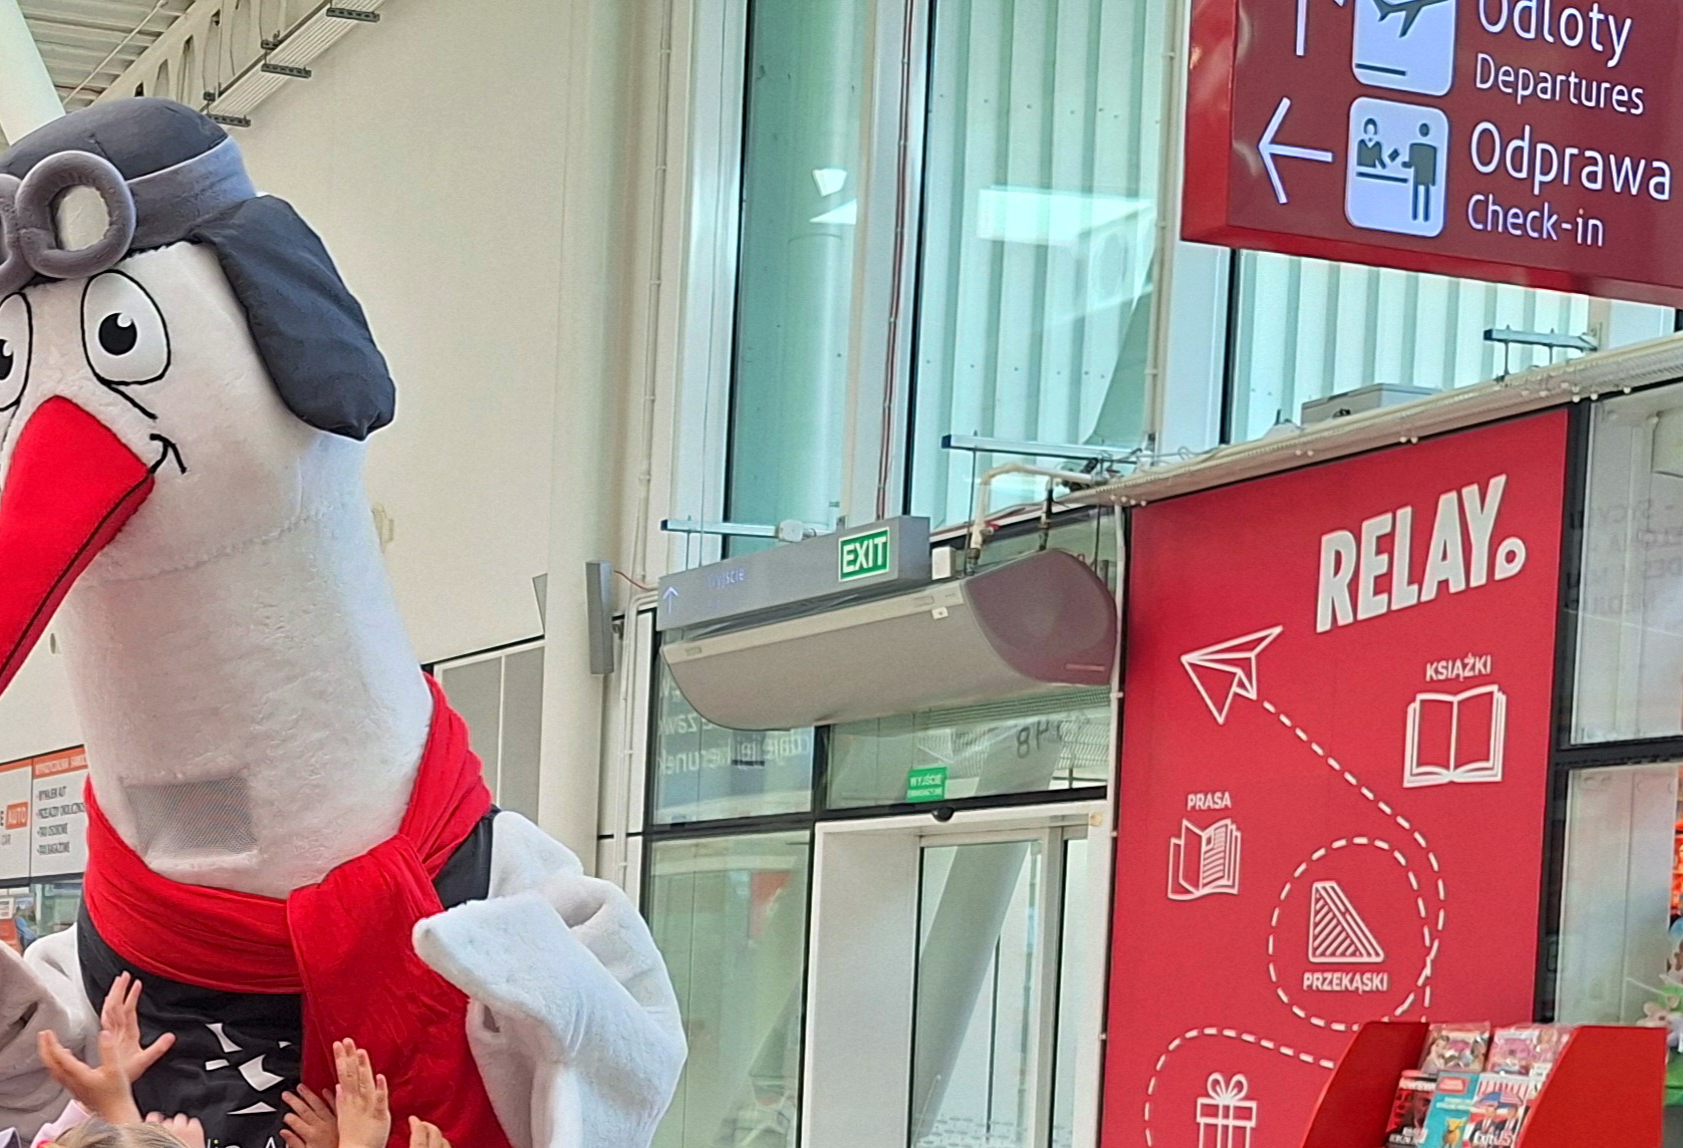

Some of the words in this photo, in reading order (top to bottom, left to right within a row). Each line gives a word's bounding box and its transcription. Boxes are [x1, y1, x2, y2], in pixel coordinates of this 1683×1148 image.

[1478, 0, 1633, 67] Odloty
[1475, 53, 1645, 115] Departures
[1470, 121, 1672, 200] Odprawa
[1467, 193, 1604, 247] Check-in
[842, 537, 887, 574] EXIT
[1426, 653, 1492, 681] KSIĄŻKI
[1187, 791, 1232, 811] PRASA
[1302, 972, 1388, 994] PRZEKĄSKI
